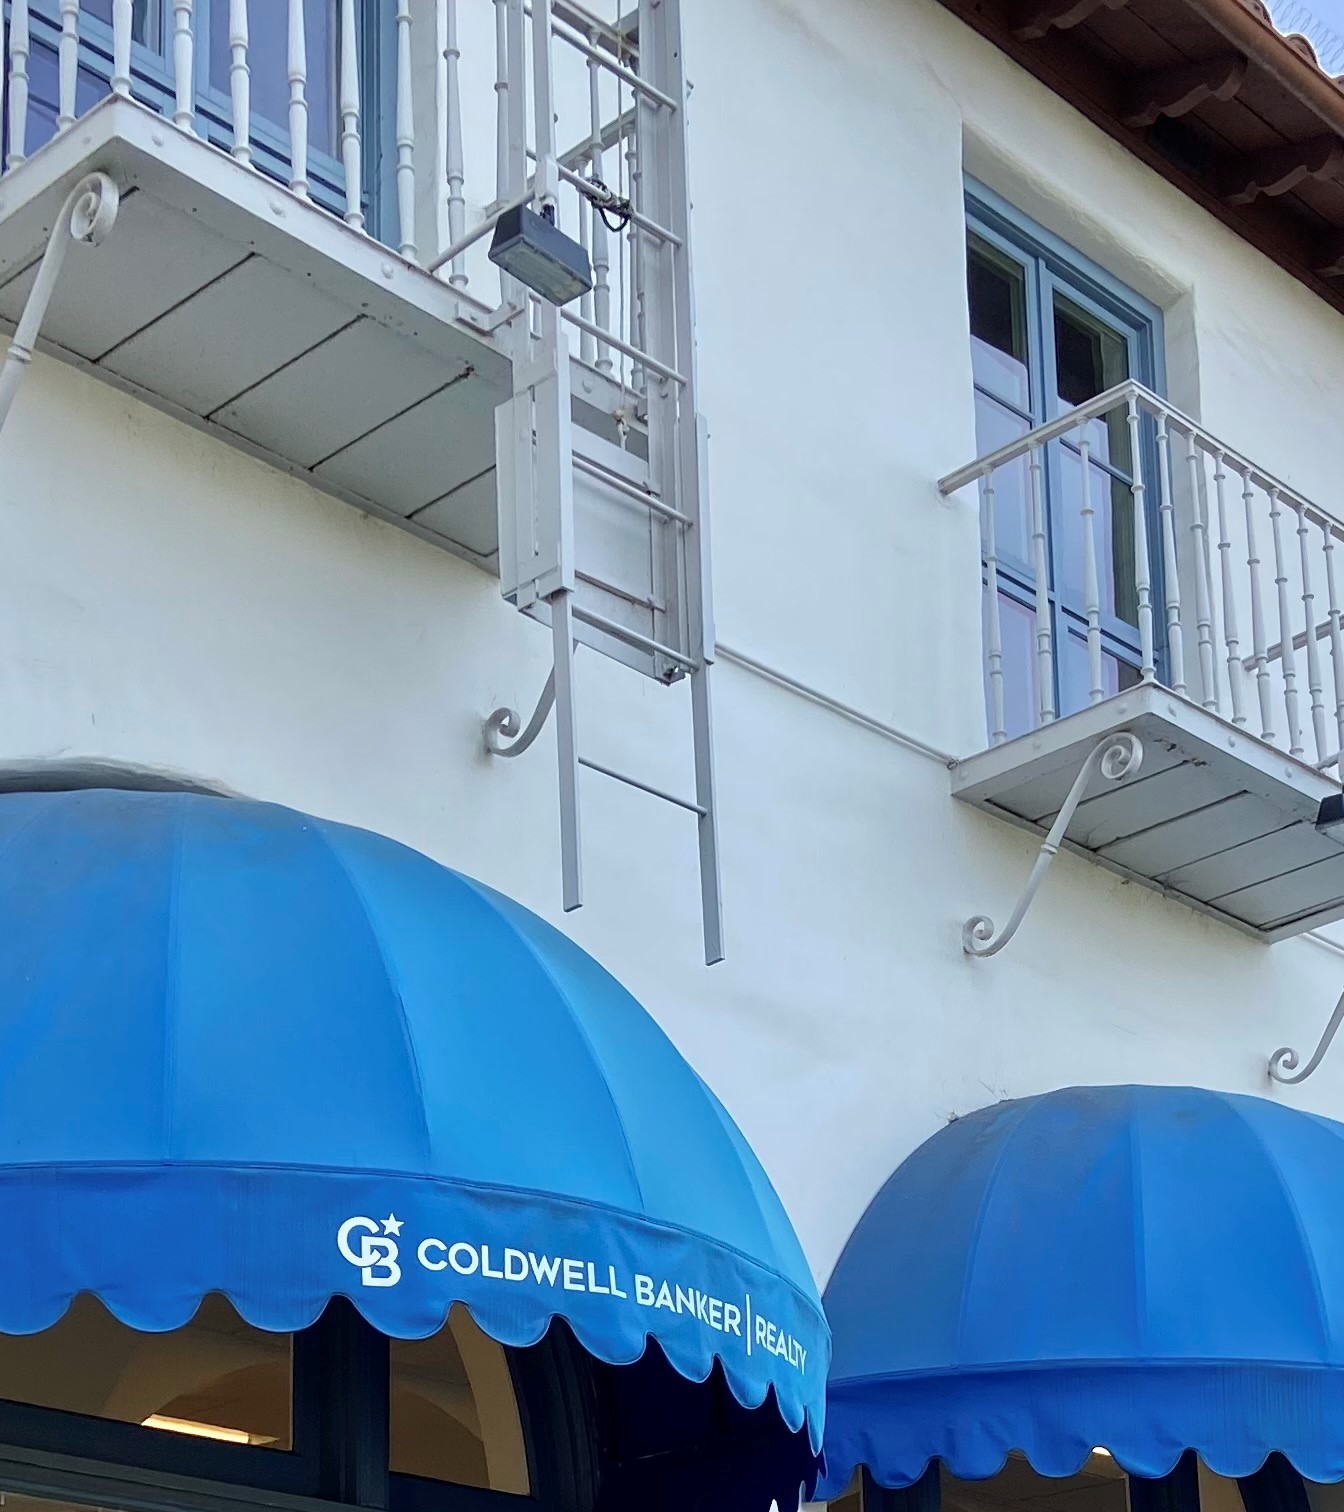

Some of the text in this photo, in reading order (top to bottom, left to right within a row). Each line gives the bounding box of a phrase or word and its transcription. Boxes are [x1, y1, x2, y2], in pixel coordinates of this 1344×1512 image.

[417, 1236, 807, 1376] COLDWELL BANKER REALTY
